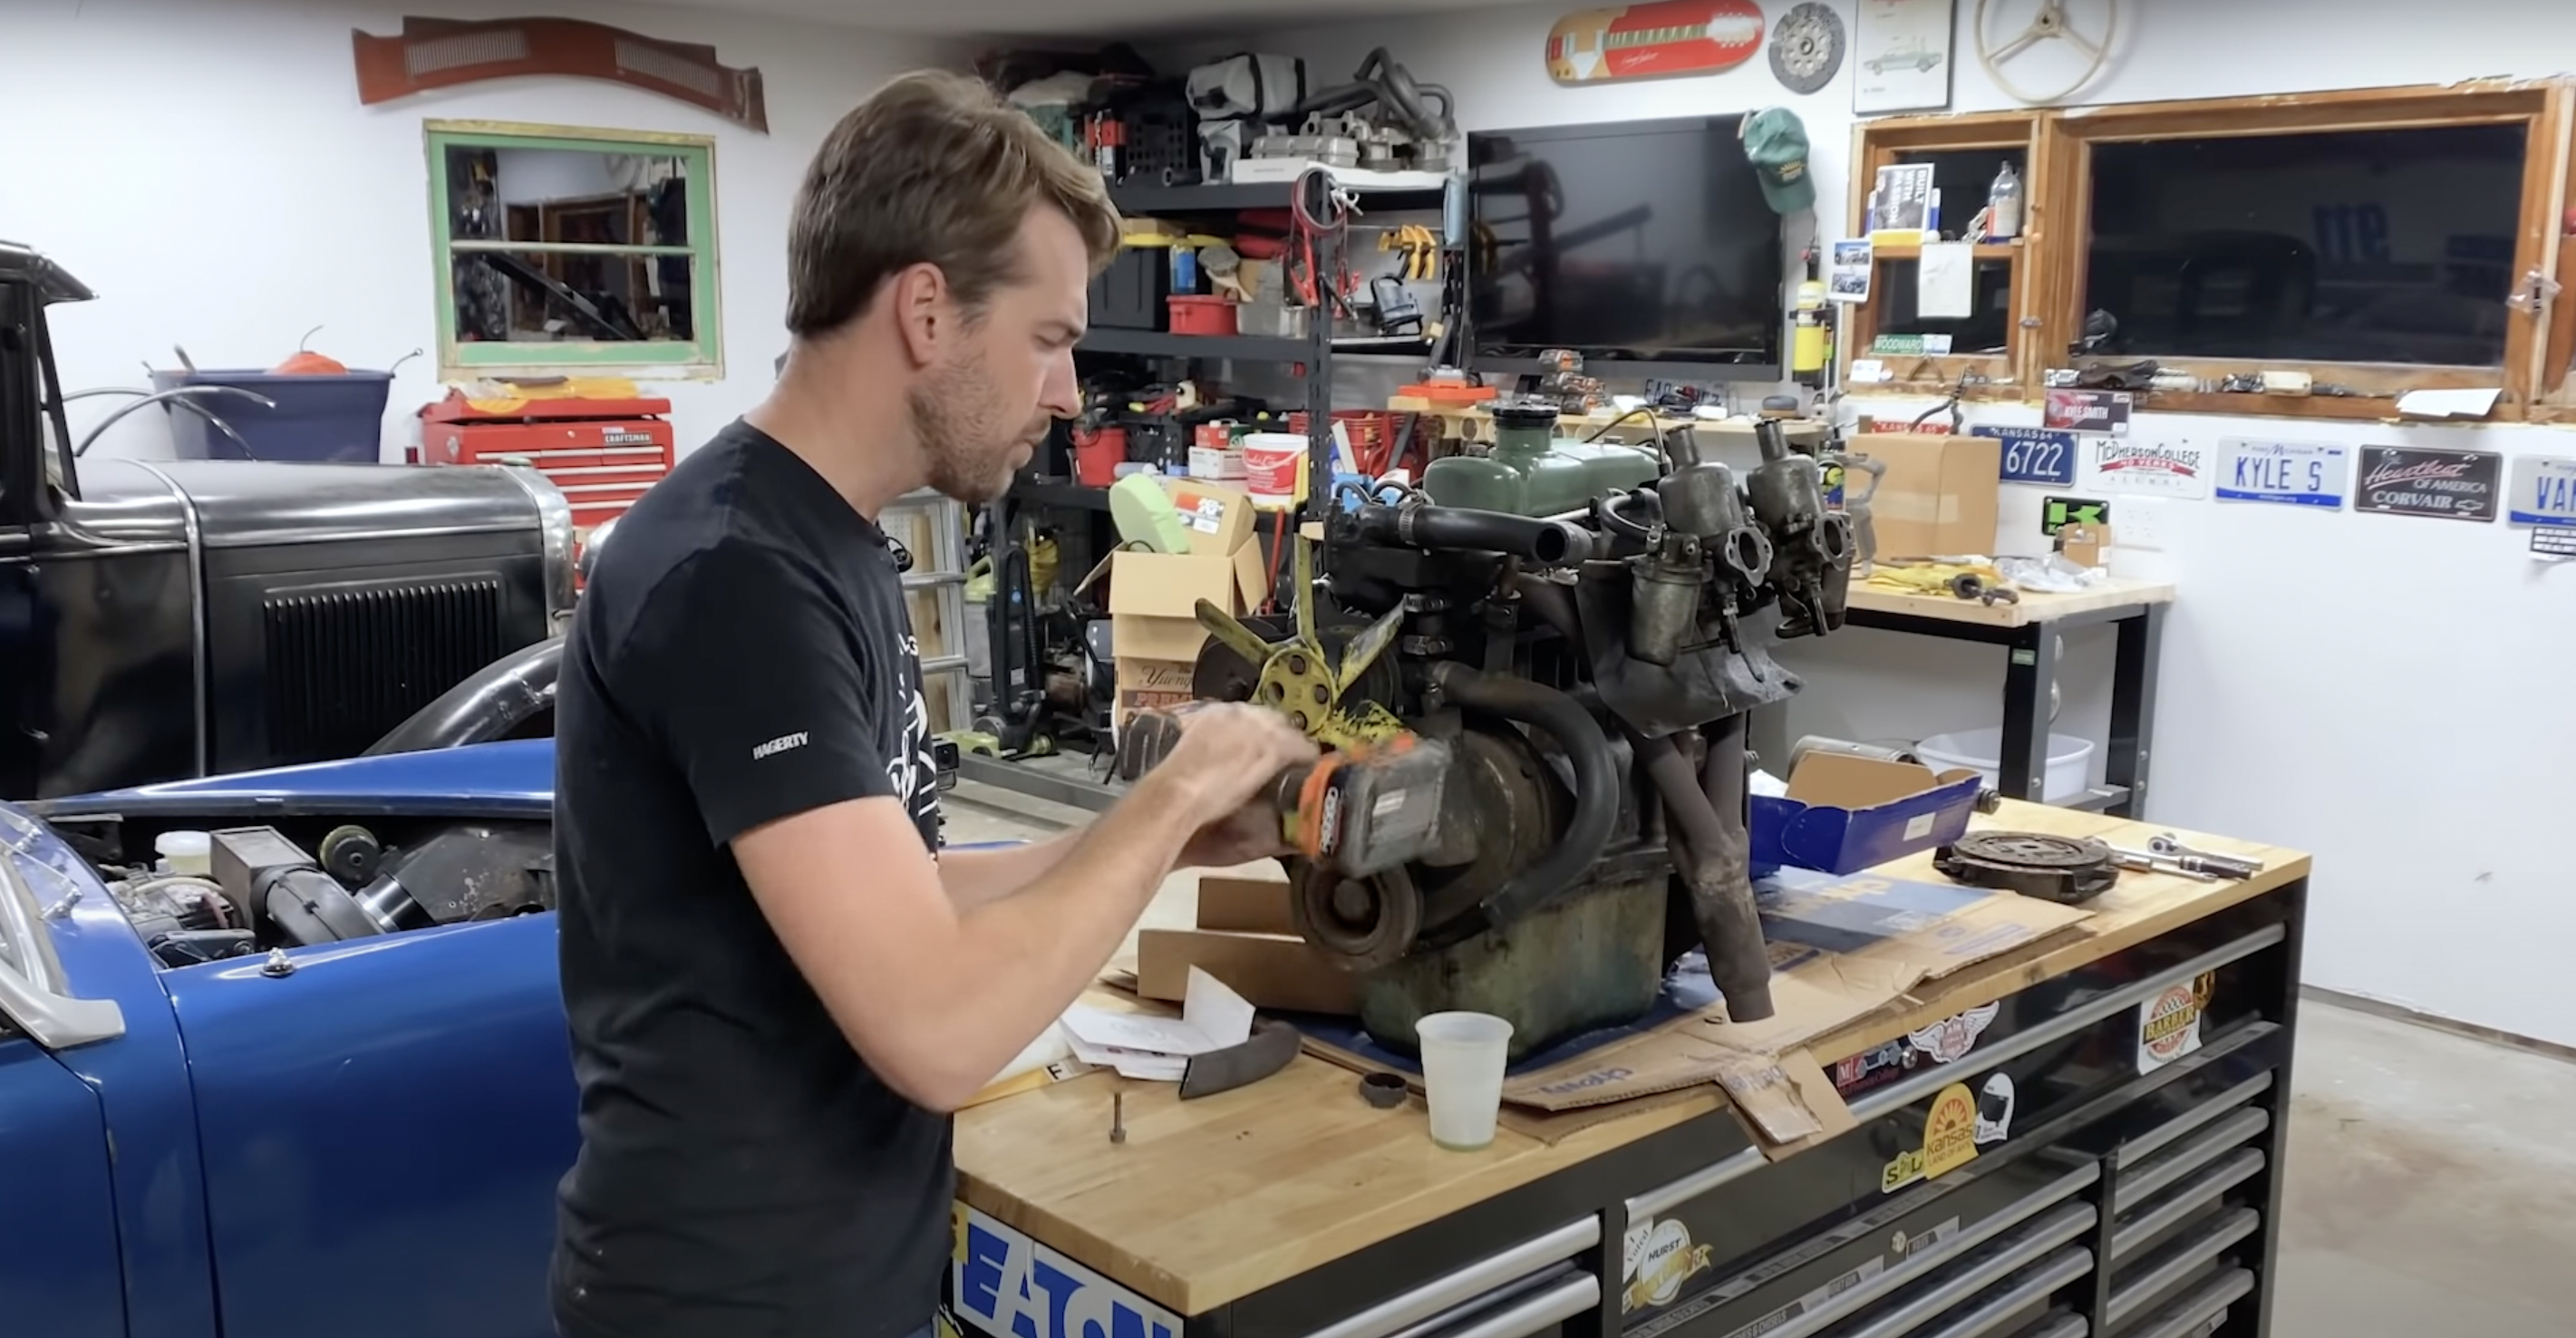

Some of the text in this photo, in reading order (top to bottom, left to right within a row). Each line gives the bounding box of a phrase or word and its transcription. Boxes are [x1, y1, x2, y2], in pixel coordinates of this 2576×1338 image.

[1903, 169, 1915, 201] WITH
[1914, 169, 1928, 204] BUILT
[2084, 406, 2109, 420] SMITH
[1993, 429, 2038, 440] KANSAS
[2006, 441, 2064, 477] 6722
[2364, 459, 2473, 487] Heartbeat
[2235, 456, 2322, 492] KYLE S
[2413, 479, 2488, 494] OF AMERICA
[2371, 490, 2455, 509] CORVAIR
[1139, 665, 1193, 689] Yueng
[752, 731, 809, 761] HAGERTY
[2145, 1004, 2196, 1040] BARBER
[1926, 1124, 1973, 1157] kansas
[1647, 1237, 1681, 1263] HURST
